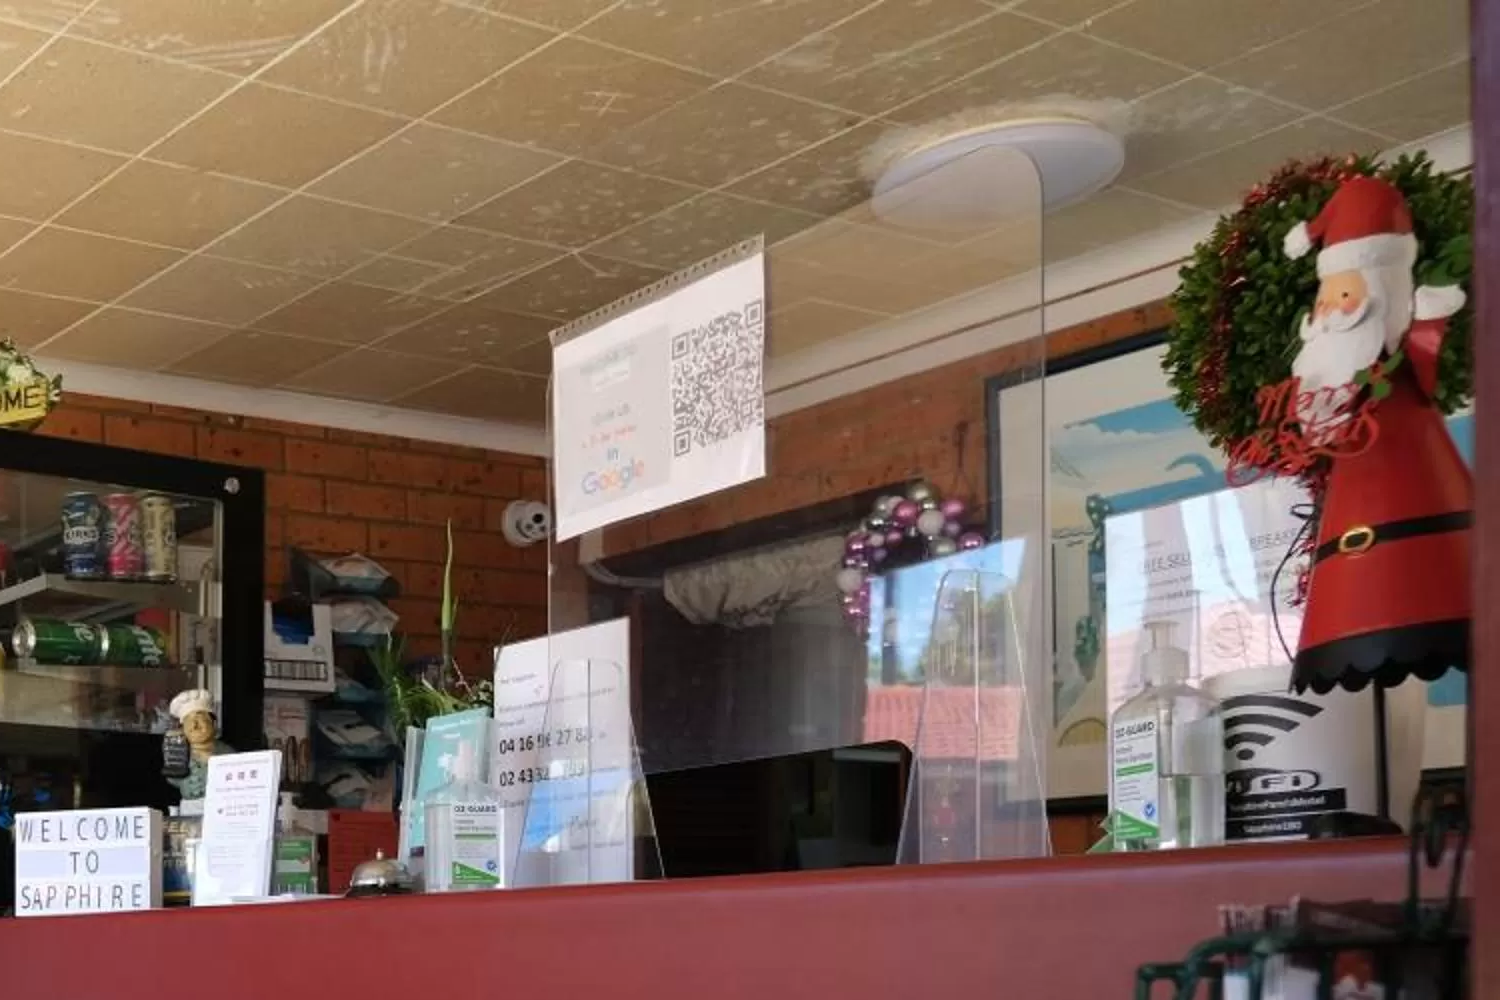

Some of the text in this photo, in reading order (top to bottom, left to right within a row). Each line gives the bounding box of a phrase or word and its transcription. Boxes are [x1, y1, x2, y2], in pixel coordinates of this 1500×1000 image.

[581, 456, 645, 495] Google
[499, 738, 515, 755] 04
[519, 735, 535, 752] 16
[499, 770, 515, 787] 02
[518, 767, 533, 784] 43
[19, 815, 145, 843] WELCOME
[69, 849, 100, 875] TO
[20, 883, 143, 910] SAPPHIRE
